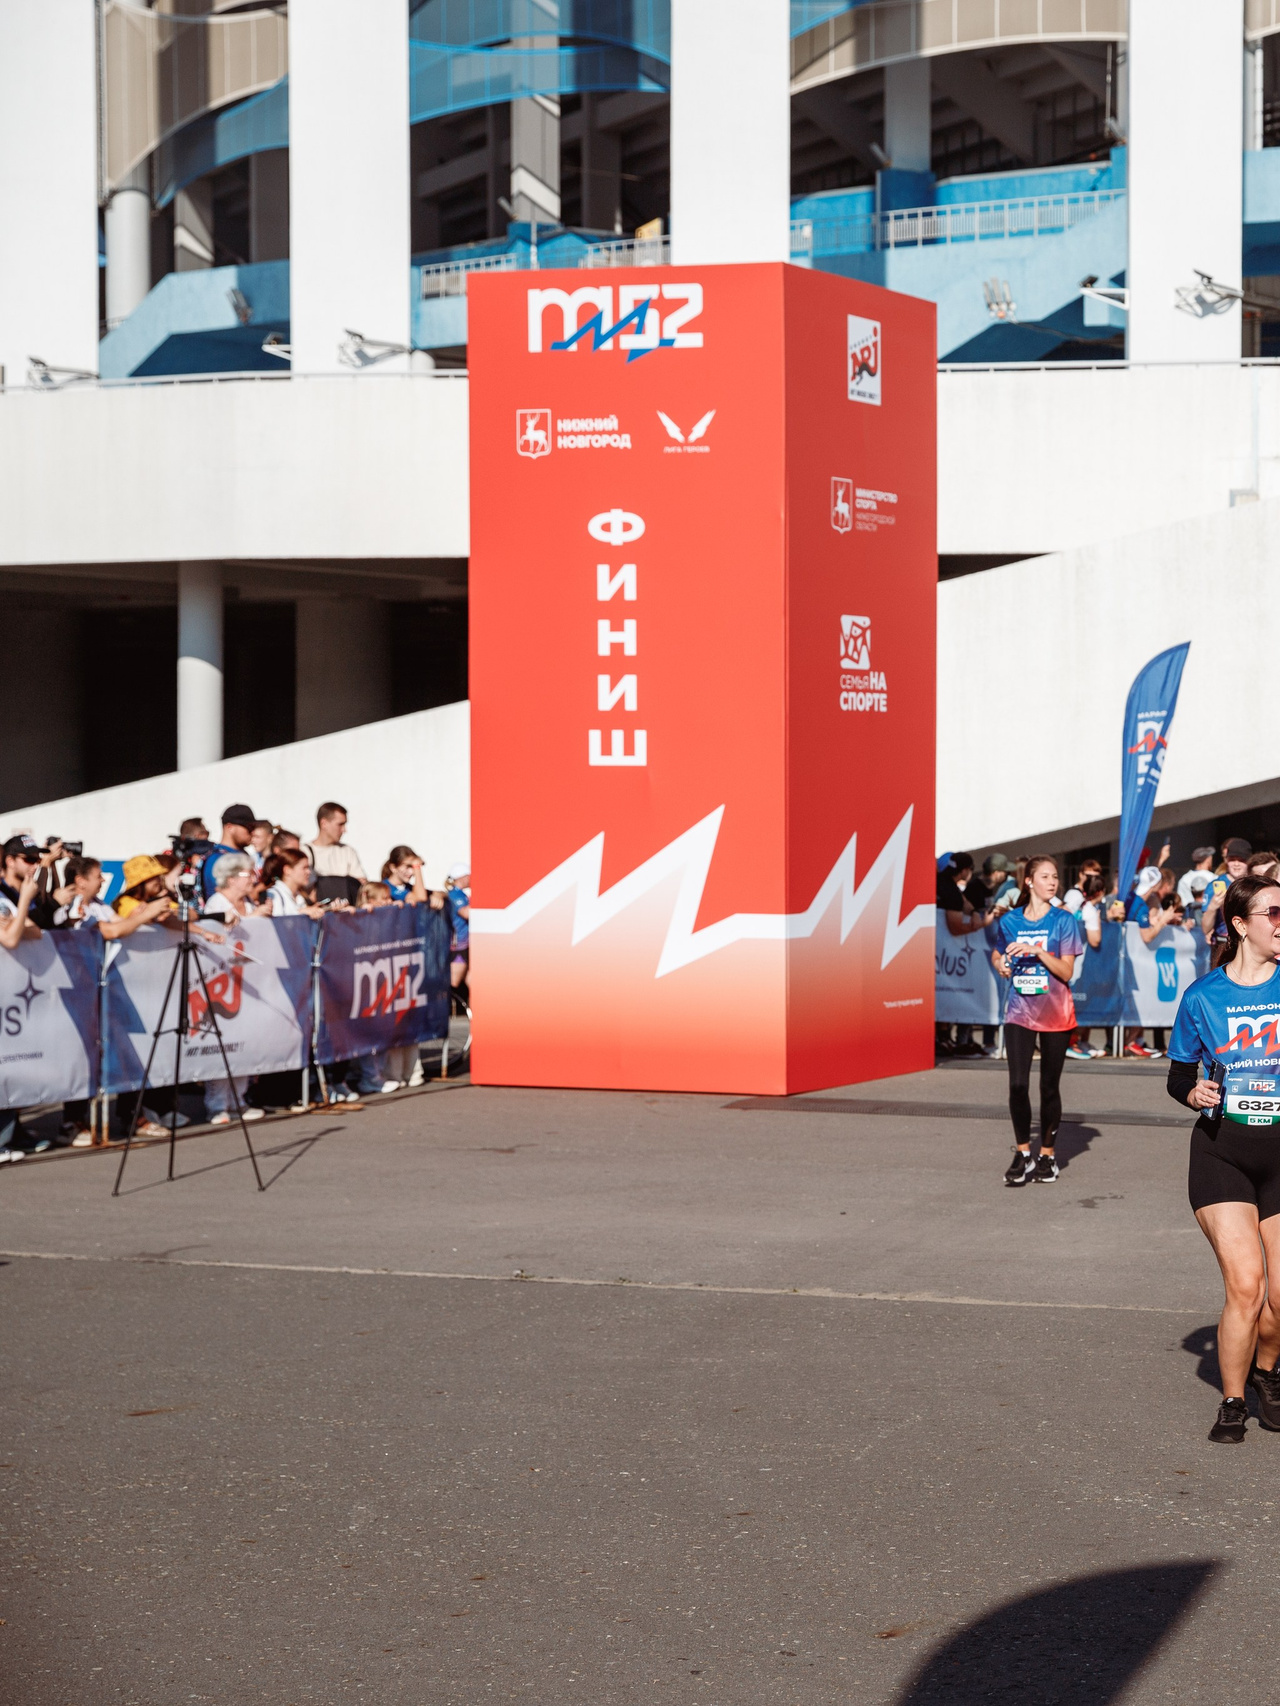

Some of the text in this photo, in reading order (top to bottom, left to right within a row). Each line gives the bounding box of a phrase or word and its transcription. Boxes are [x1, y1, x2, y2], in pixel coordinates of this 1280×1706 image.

[557, 414, 619, 432] НИЖНИЙ
[557, 433, 632, 449] НОВГОРОД
[587, 508, 648, 767] ФИНИШ
[840, 671, 888, 691] СЕМЬЯ НА
[839, 691, 888, 712] СПОРТЕ
[1158, 962, 1176, 988] VK
